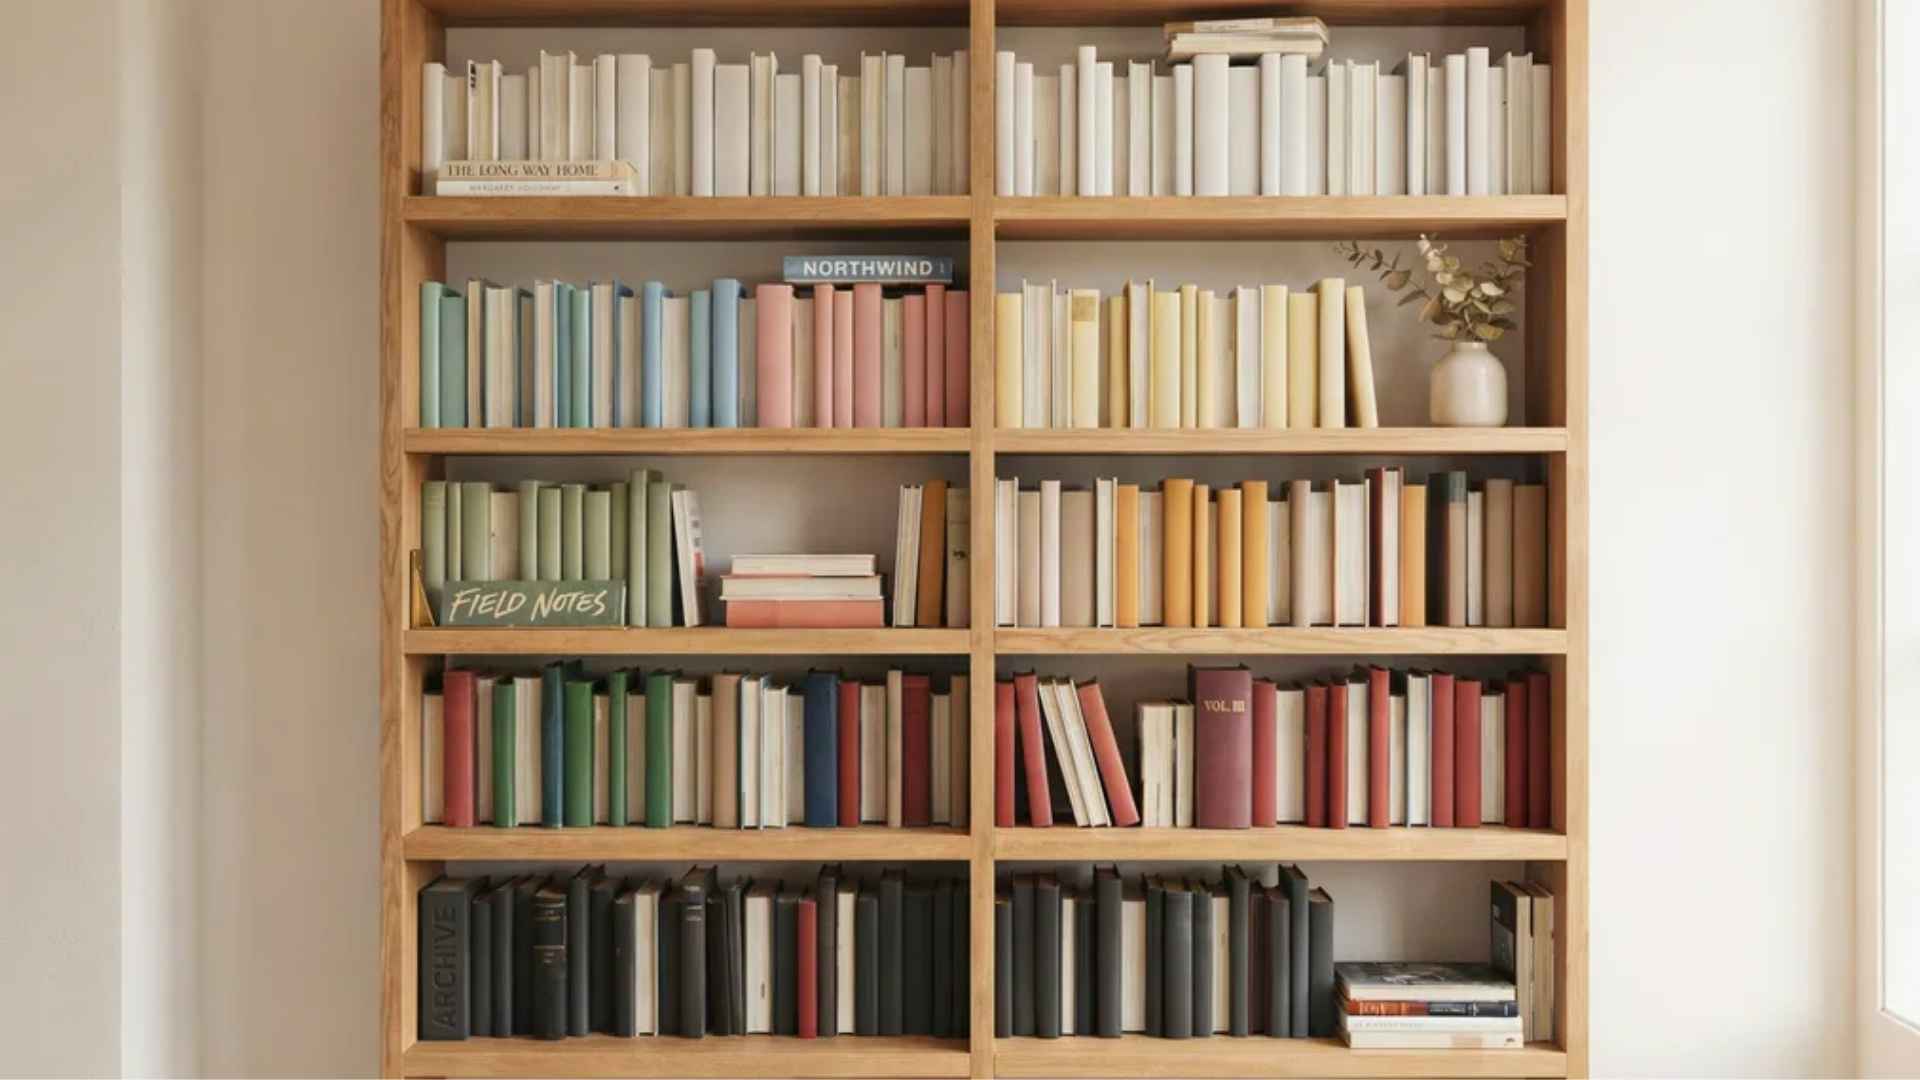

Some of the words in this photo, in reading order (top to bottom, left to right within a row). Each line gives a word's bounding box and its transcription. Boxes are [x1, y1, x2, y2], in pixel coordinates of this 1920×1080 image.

[448, 164, 473, 176] THE
[479, 164, 519, 177] LONG
[523, 164, 551, 176] WAY
[557, 164, 599, 177] HOME
[803, 260, 933, 276] NORTHWIND
[449, 587, 527, 622] FIELD
[530, 587, 608, 622] NOTES
[433, 902, 457, 1032] ARCHIVE
